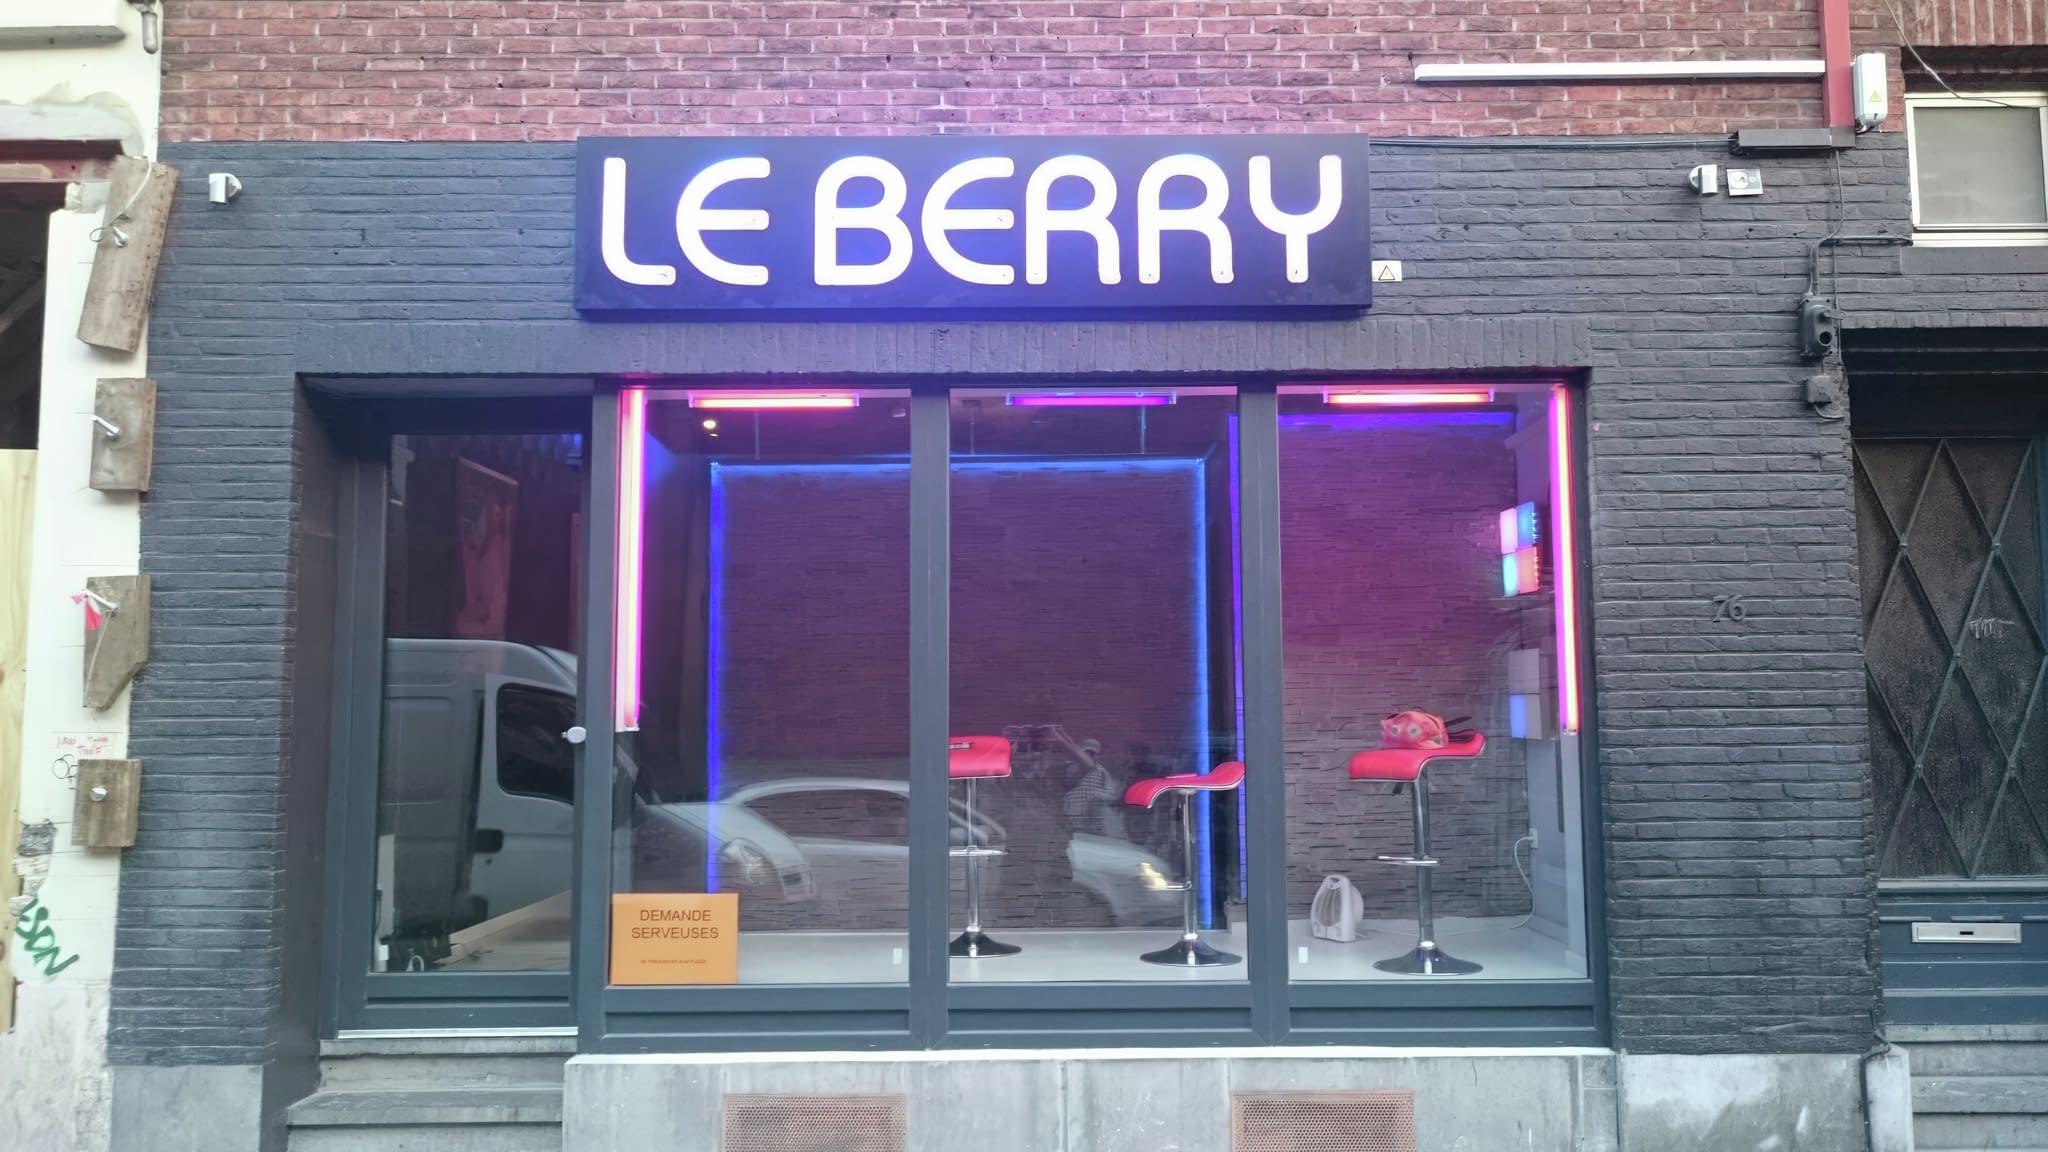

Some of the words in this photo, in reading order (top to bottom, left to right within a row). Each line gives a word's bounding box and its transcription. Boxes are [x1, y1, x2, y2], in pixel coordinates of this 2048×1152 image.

[601, 156, 771, 286] LE
[813, 154, 1344, 286] BERRY
[1711, 595, 1746, 622] 76
[639, 909, 712, 921] DEMANDE
[631, 927, 720, 939] SERVEUSES
